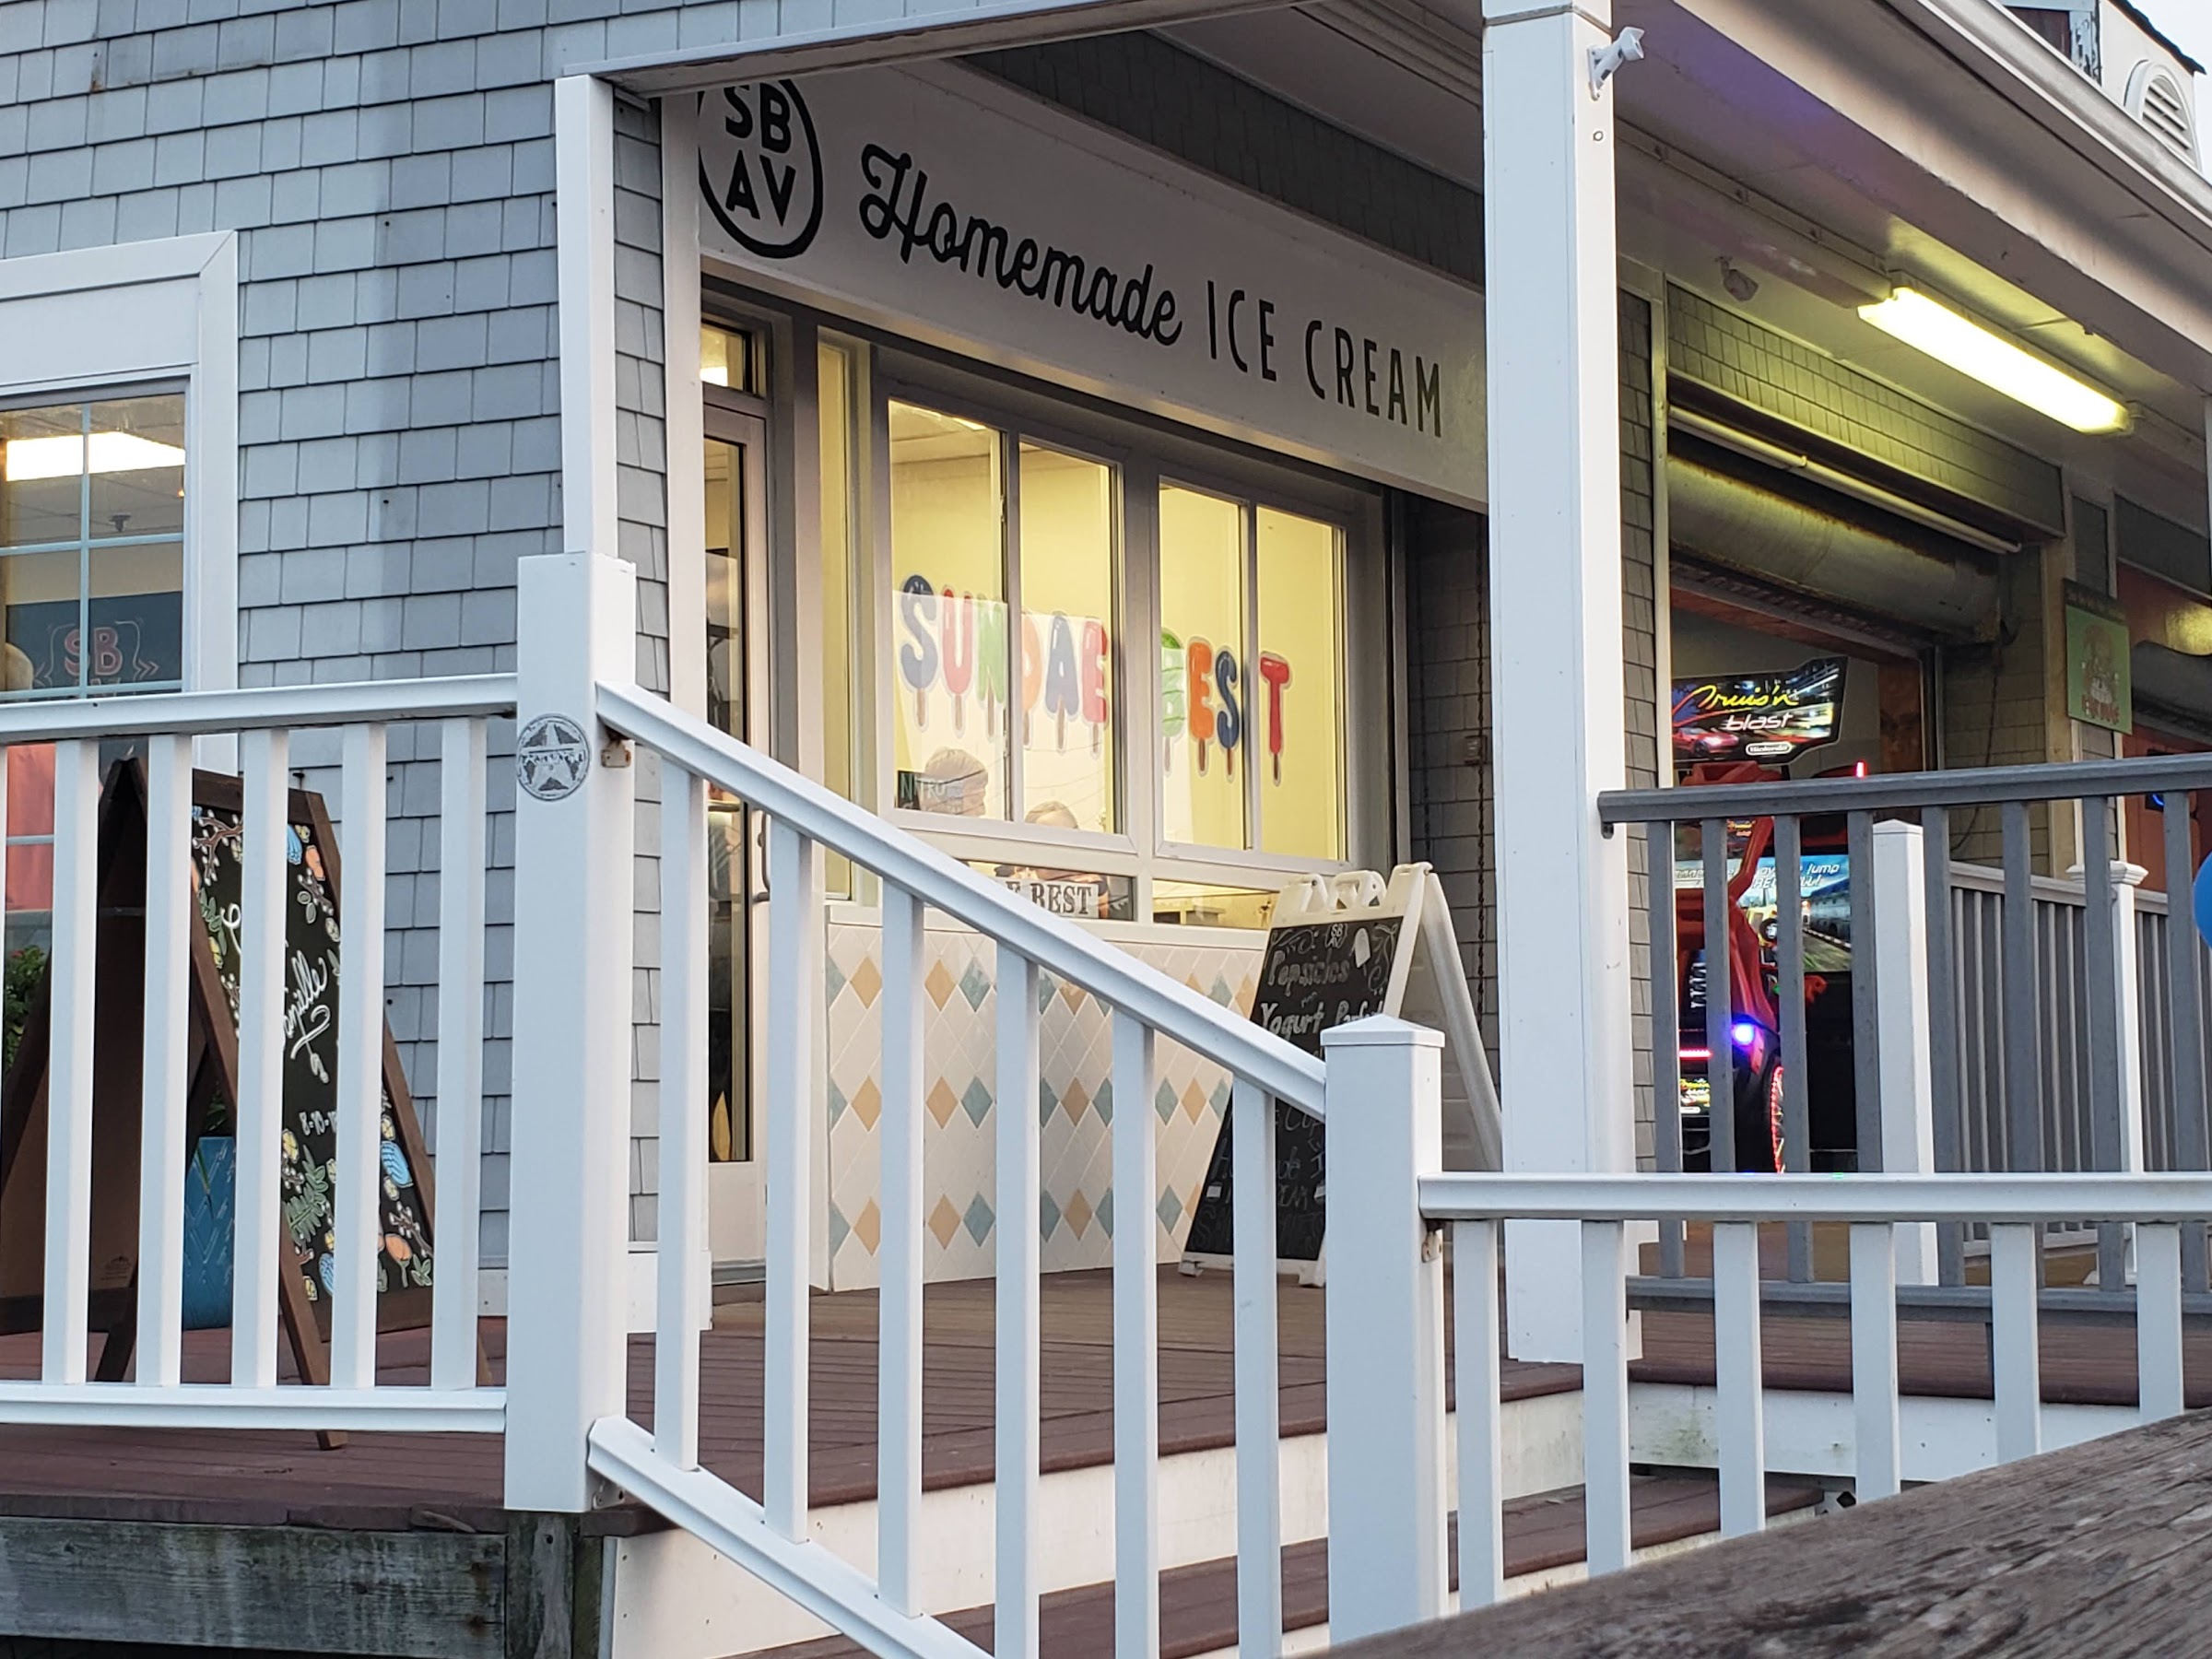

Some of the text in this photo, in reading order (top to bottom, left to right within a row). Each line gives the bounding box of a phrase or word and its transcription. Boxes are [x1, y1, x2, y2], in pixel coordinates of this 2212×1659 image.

[724, 82, 792, 154] SB
[725, 149, 796, 227] AV
[860, 143, 1443, 439] Homemade ICE CREAM
[900, 573, 1109, 730] SUNDAE
[1722, 712, 1793, 731] blast
[1030, 882, 1091, 915] BEST
